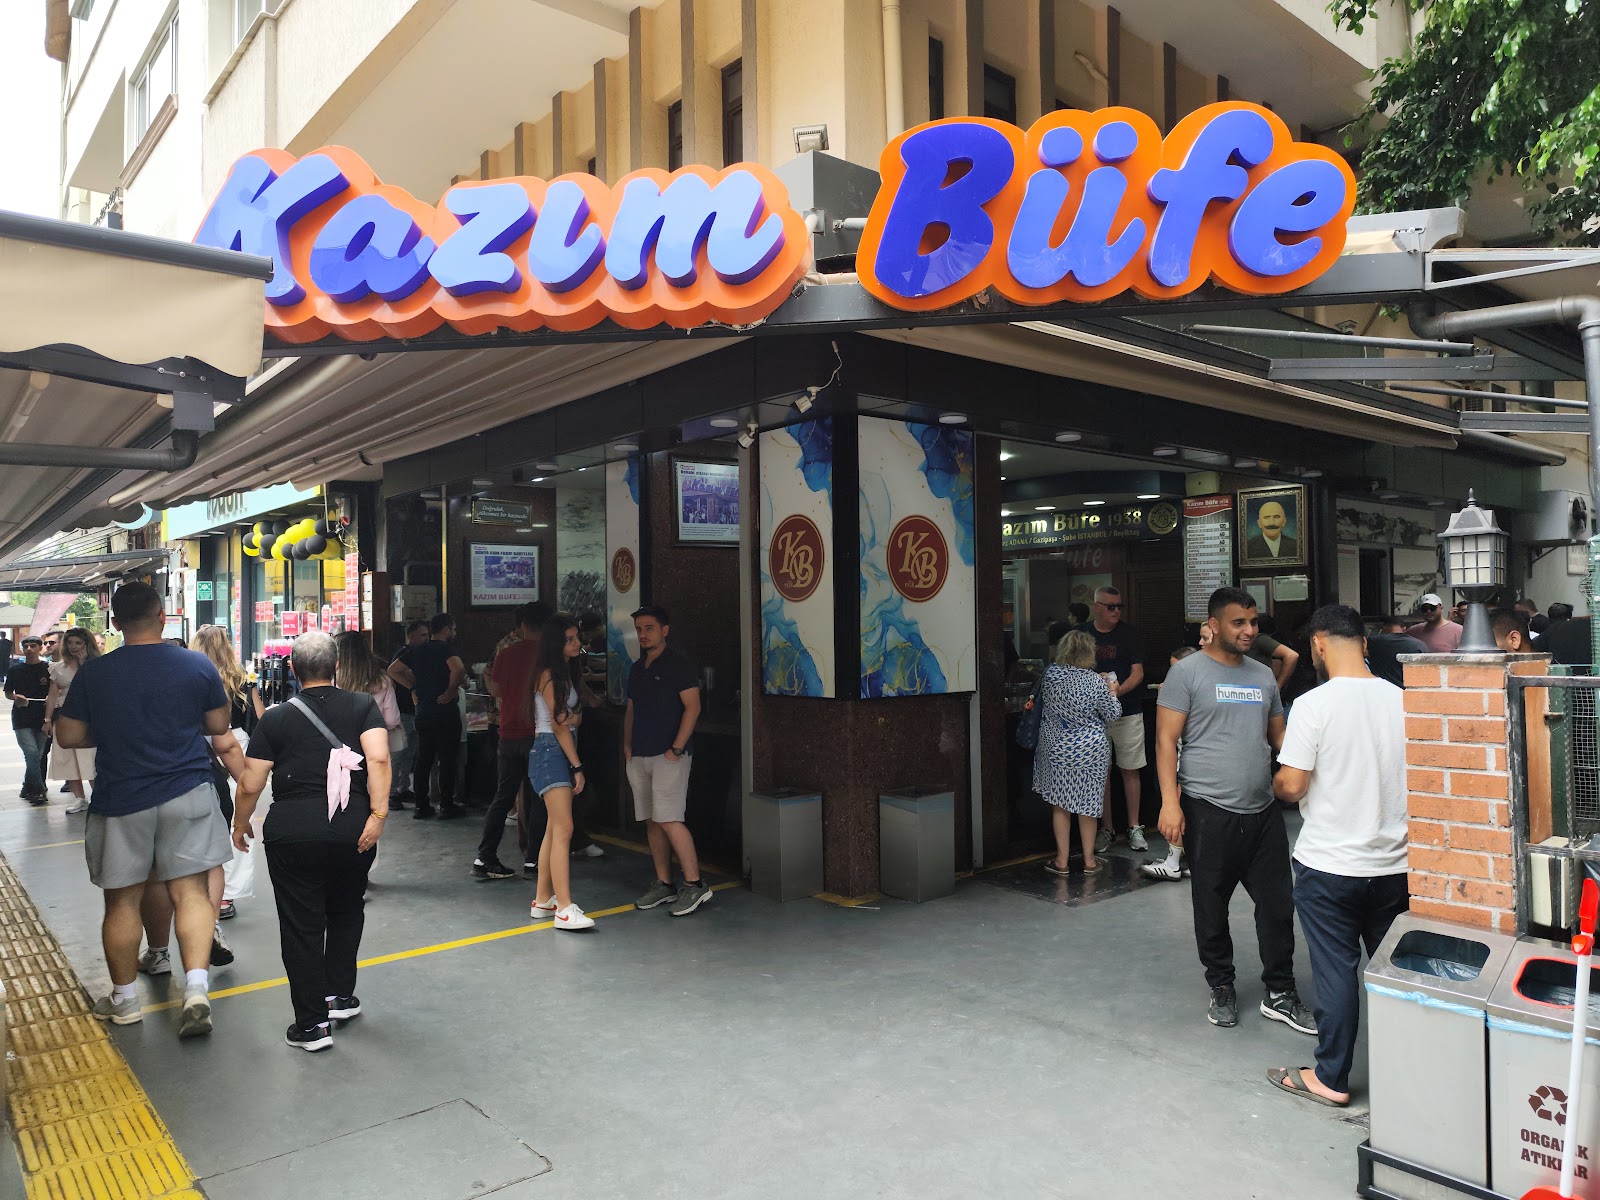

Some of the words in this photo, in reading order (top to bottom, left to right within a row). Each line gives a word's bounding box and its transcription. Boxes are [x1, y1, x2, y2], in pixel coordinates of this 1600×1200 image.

[192, 154, 786, 305] Kazım
[874, 109, 1347, 298] Büfe
[1003, 519, 1048, 537] azım
[1053, 511, 1101, 532] Büfe
[1107, 510, 1142, 527] 1938
[1078, 528, 1107, 540] İSTANBUL
[778, 530, 814, 589] KB
[898, 531, 938, 589] KB
[1217, 688, 1256, 700] hummel
[1520, 1128, 1589, 1161] ORGAK
